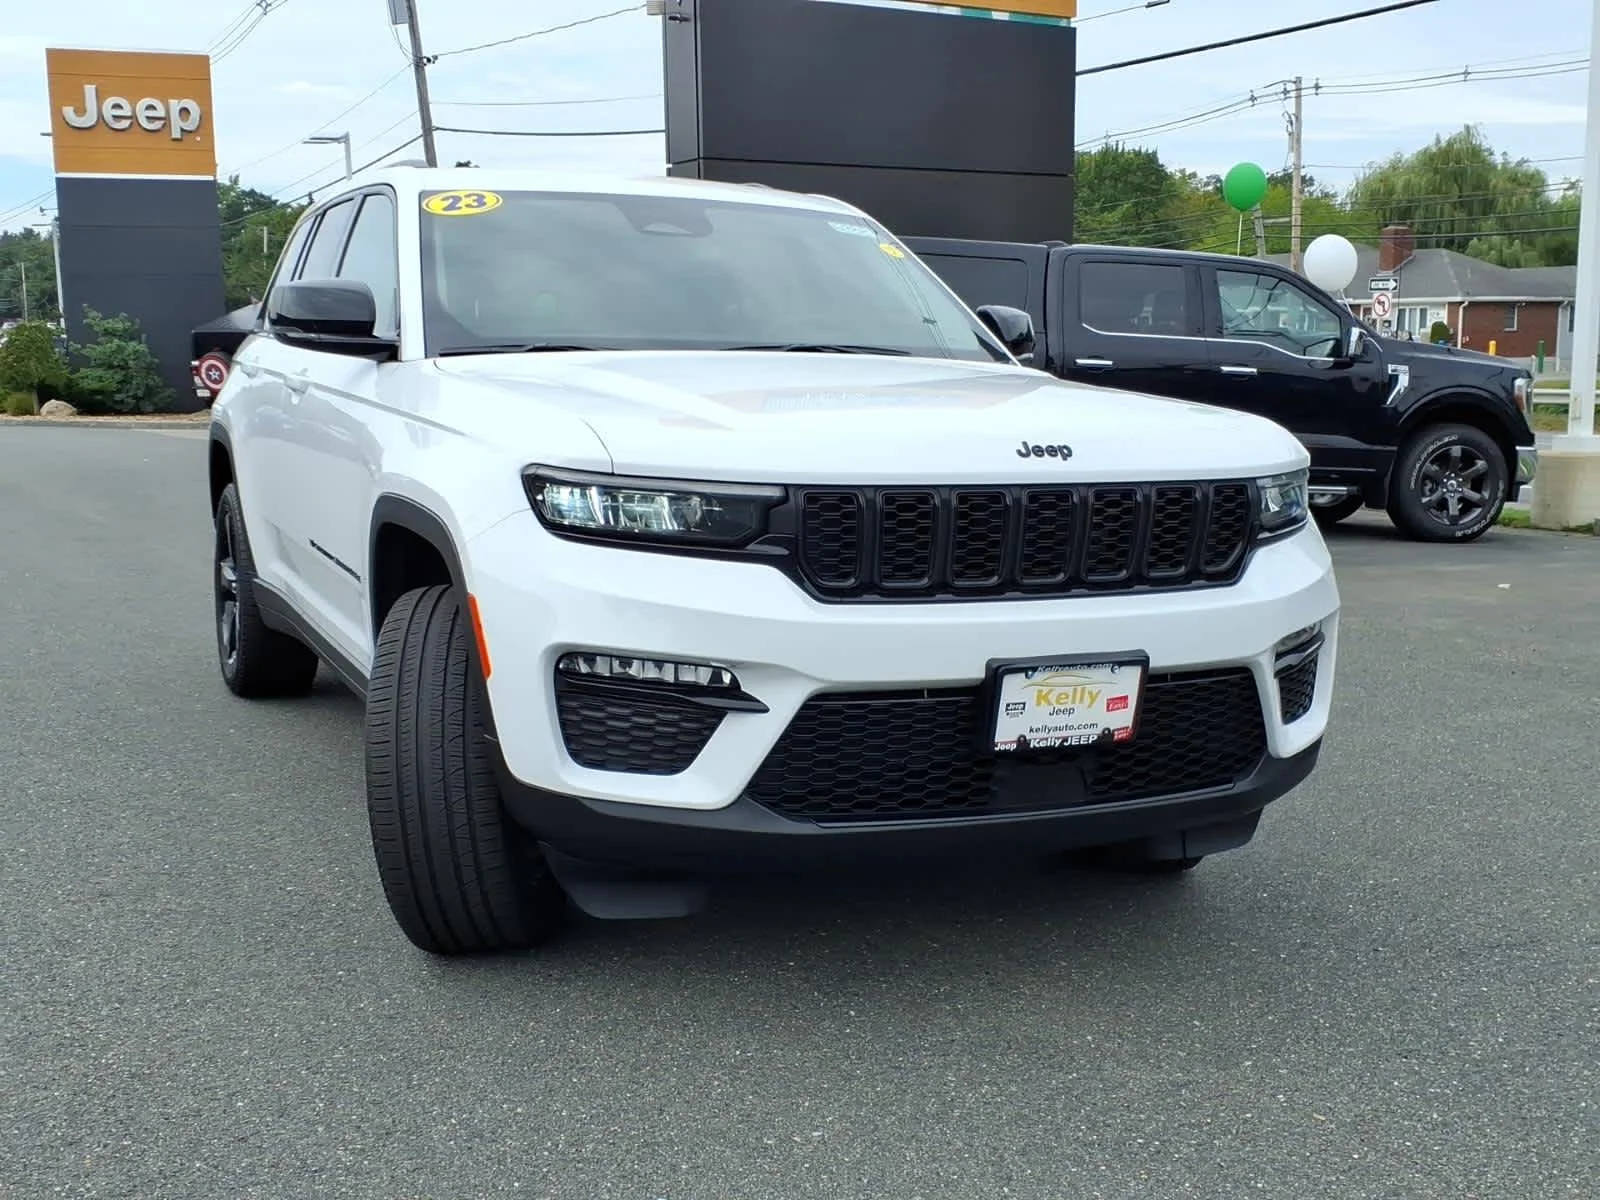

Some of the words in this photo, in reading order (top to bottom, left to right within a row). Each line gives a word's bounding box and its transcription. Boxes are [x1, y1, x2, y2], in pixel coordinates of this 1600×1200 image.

[62, 84, 201, 141] Jeep
[440, 193, 486, 211] 23
[1016, 441, 1073, 461] Jeep
[1035, 686, 1102, 708] Kelly
[1049, 706, 1075, 717] Jeep
[1029, 722, 1098, 734] kellyauto.com
[995, 741, 1017, 751] Jeep
[1030, 737, 1063, 749] Kelly
[1064, 735, 1098, 747] JEEP
